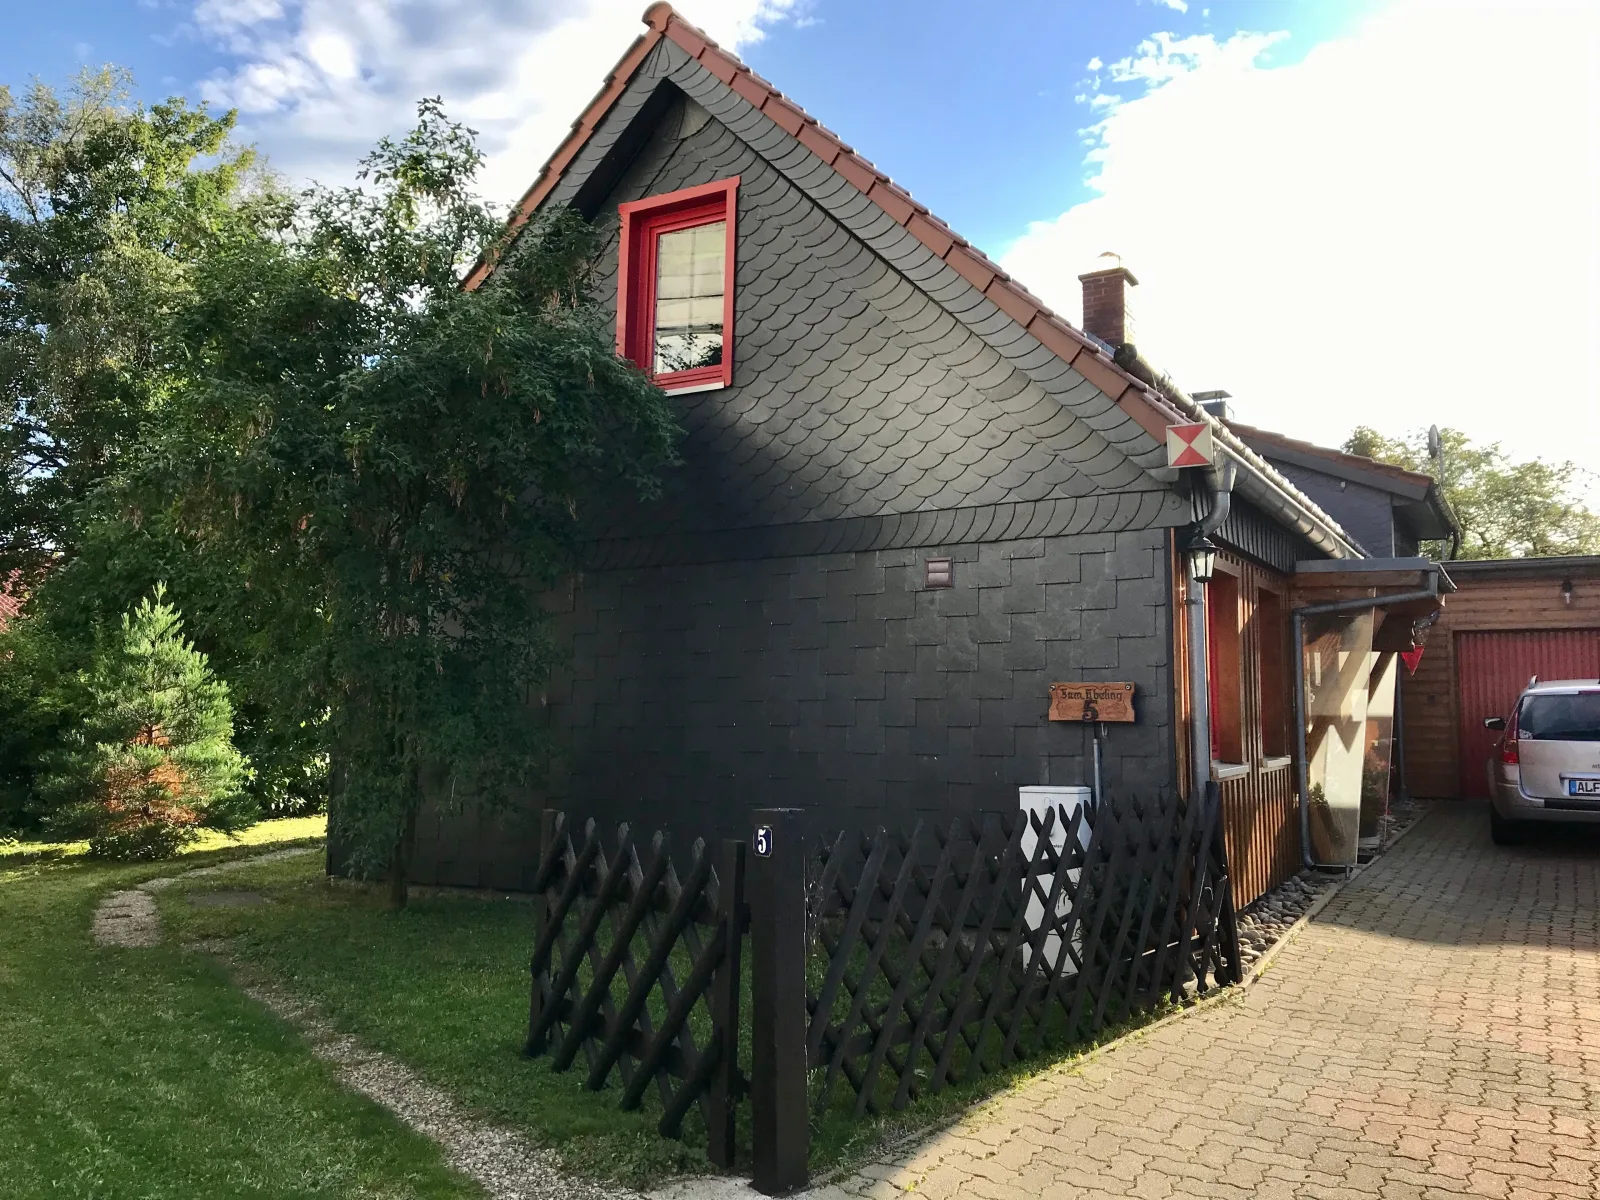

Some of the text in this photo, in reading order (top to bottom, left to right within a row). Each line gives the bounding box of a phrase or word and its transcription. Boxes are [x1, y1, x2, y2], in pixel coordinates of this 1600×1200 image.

[1082, 699, 1098, 722] 5
[1577, 781, 1600, 792] ALF
[757, 828, 767, 854] 5
